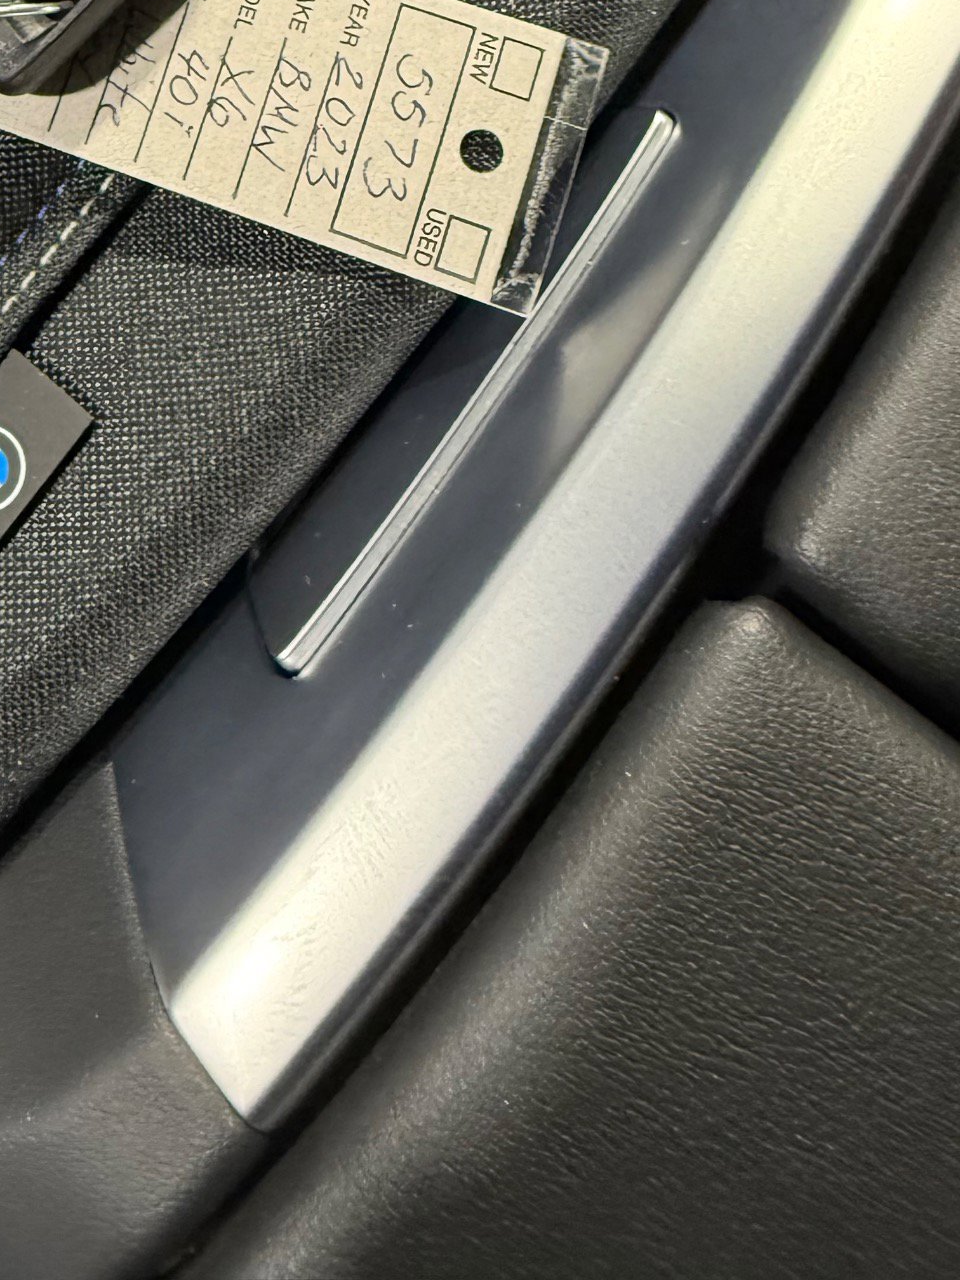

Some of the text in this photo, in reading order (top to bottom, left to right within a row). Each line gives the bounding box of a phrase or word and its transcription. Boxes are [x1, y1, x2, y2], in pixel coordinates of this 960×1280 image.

[208, 56, 255, 127] X6
[470, 32, 499, 85] NEW
[252, 56, 311, 172] BMW
[306, 51, 363, 189] 2023
[363, 54, 433, 202] 5573
[414, 208, 447, 267] USED
